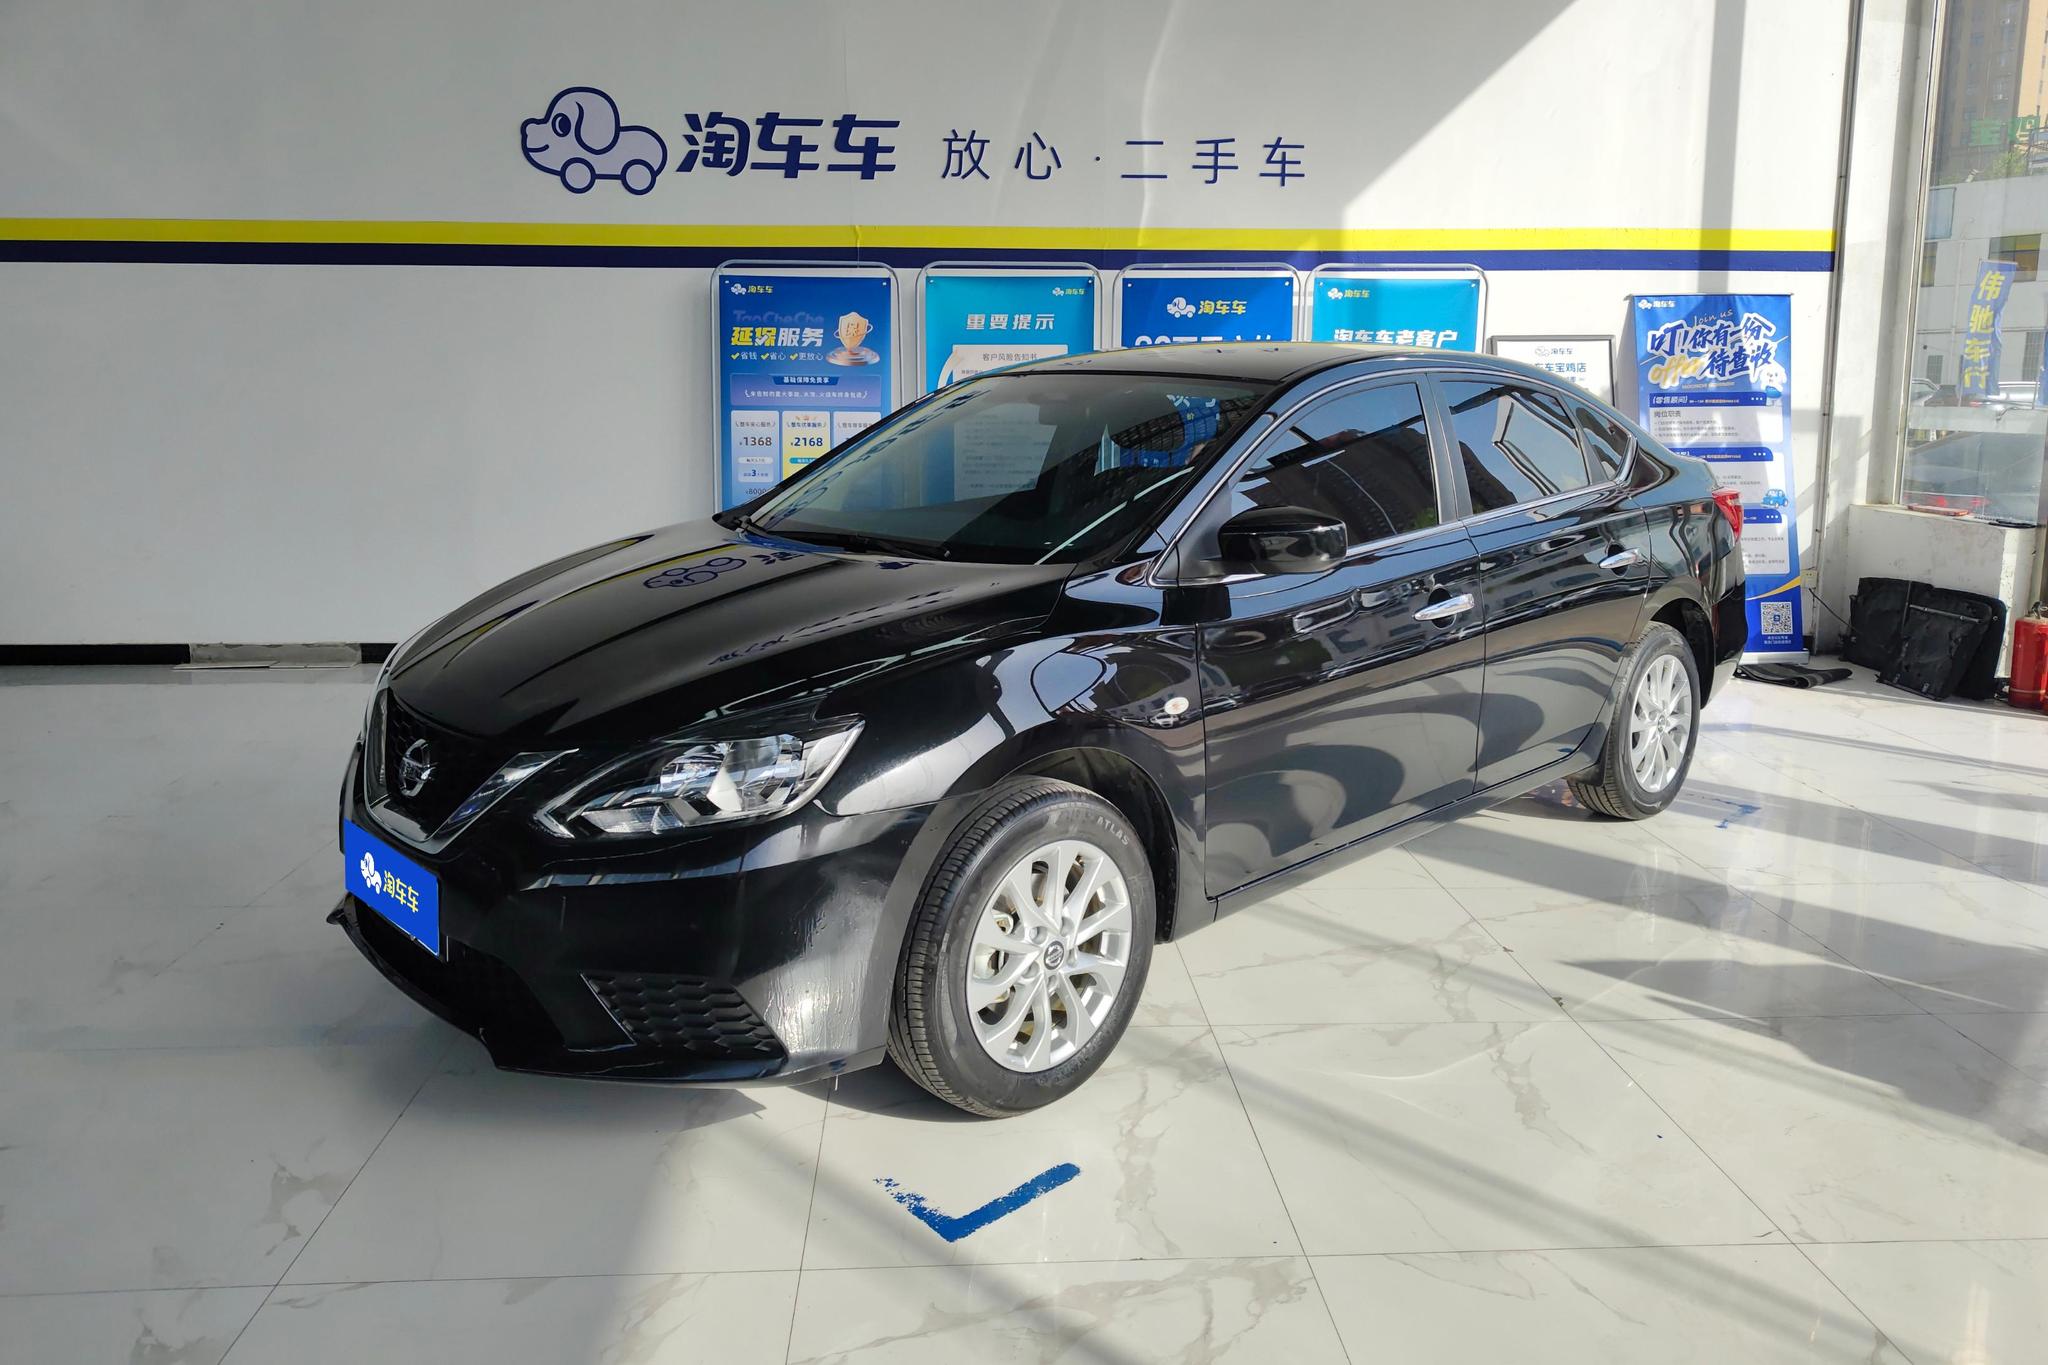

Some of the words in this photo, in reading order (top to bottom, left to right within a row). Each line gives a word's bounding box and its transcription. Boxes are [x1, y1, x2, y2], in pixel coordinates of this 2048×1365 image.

[676, 112, 900, 180] 淘车车
[1197, 300, 1247, 315] 淘车车
[966, 313, 1055, 330] 重要提示
[1963, 270, 2006, 390] 伟驰车行
[731, 326, 824, 347] 延保服务
[1334, 329, 1458, 348] 淘车车老客户
[741, 352, 757, 360] 省钱
[770, 352, 786, 360] 省心
[799, 352, 824, 360] 更放心
[1097, 815, 1130, 846] ATLAS
[383, 870, 420, 913] 淘车车
